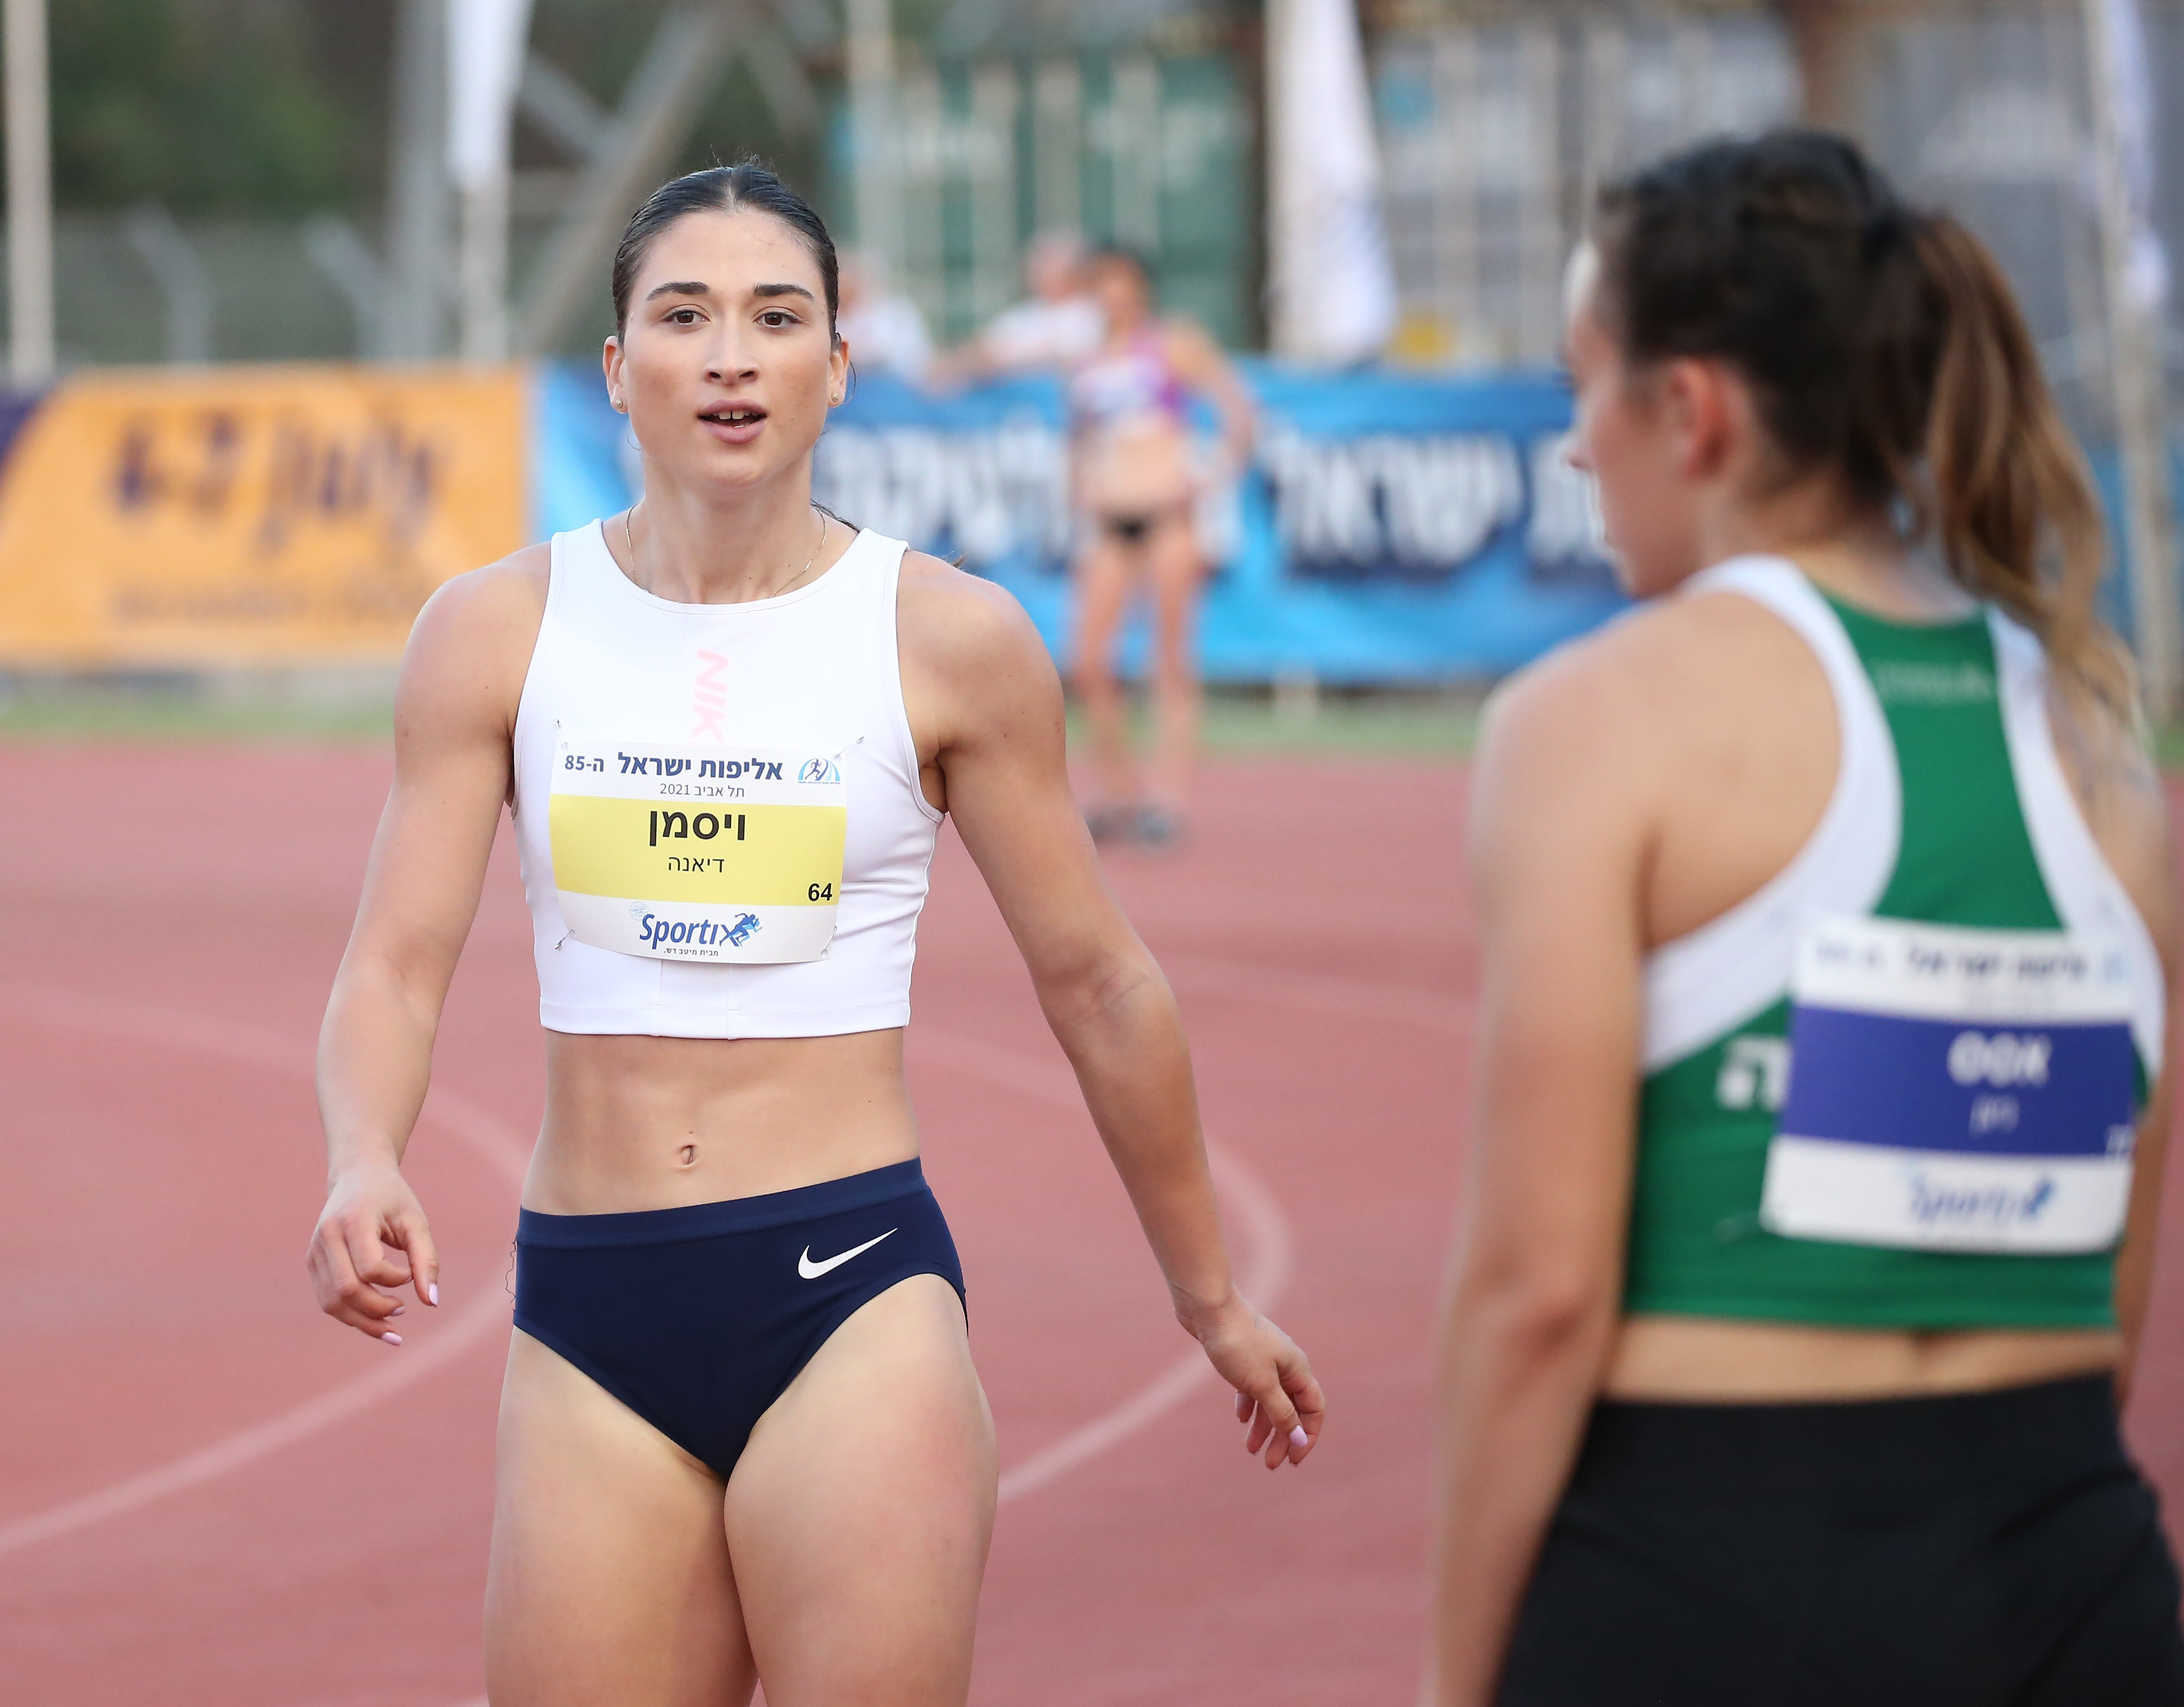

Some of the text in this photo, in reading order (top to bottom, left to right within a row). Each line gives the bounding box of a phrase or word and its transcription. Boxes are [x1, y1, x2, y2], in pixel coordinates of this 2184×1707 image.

[691, 648, 729, 747] NIK
[565, 751, 783, 781] אליפות ישראל ה-85
[660, 783, 745, 798] תל אביב 2021
[649, 811, 746, 847] ויסמן
[668, 856, 725, 873] דיאנה
[808, 882, 833, 902] 64
